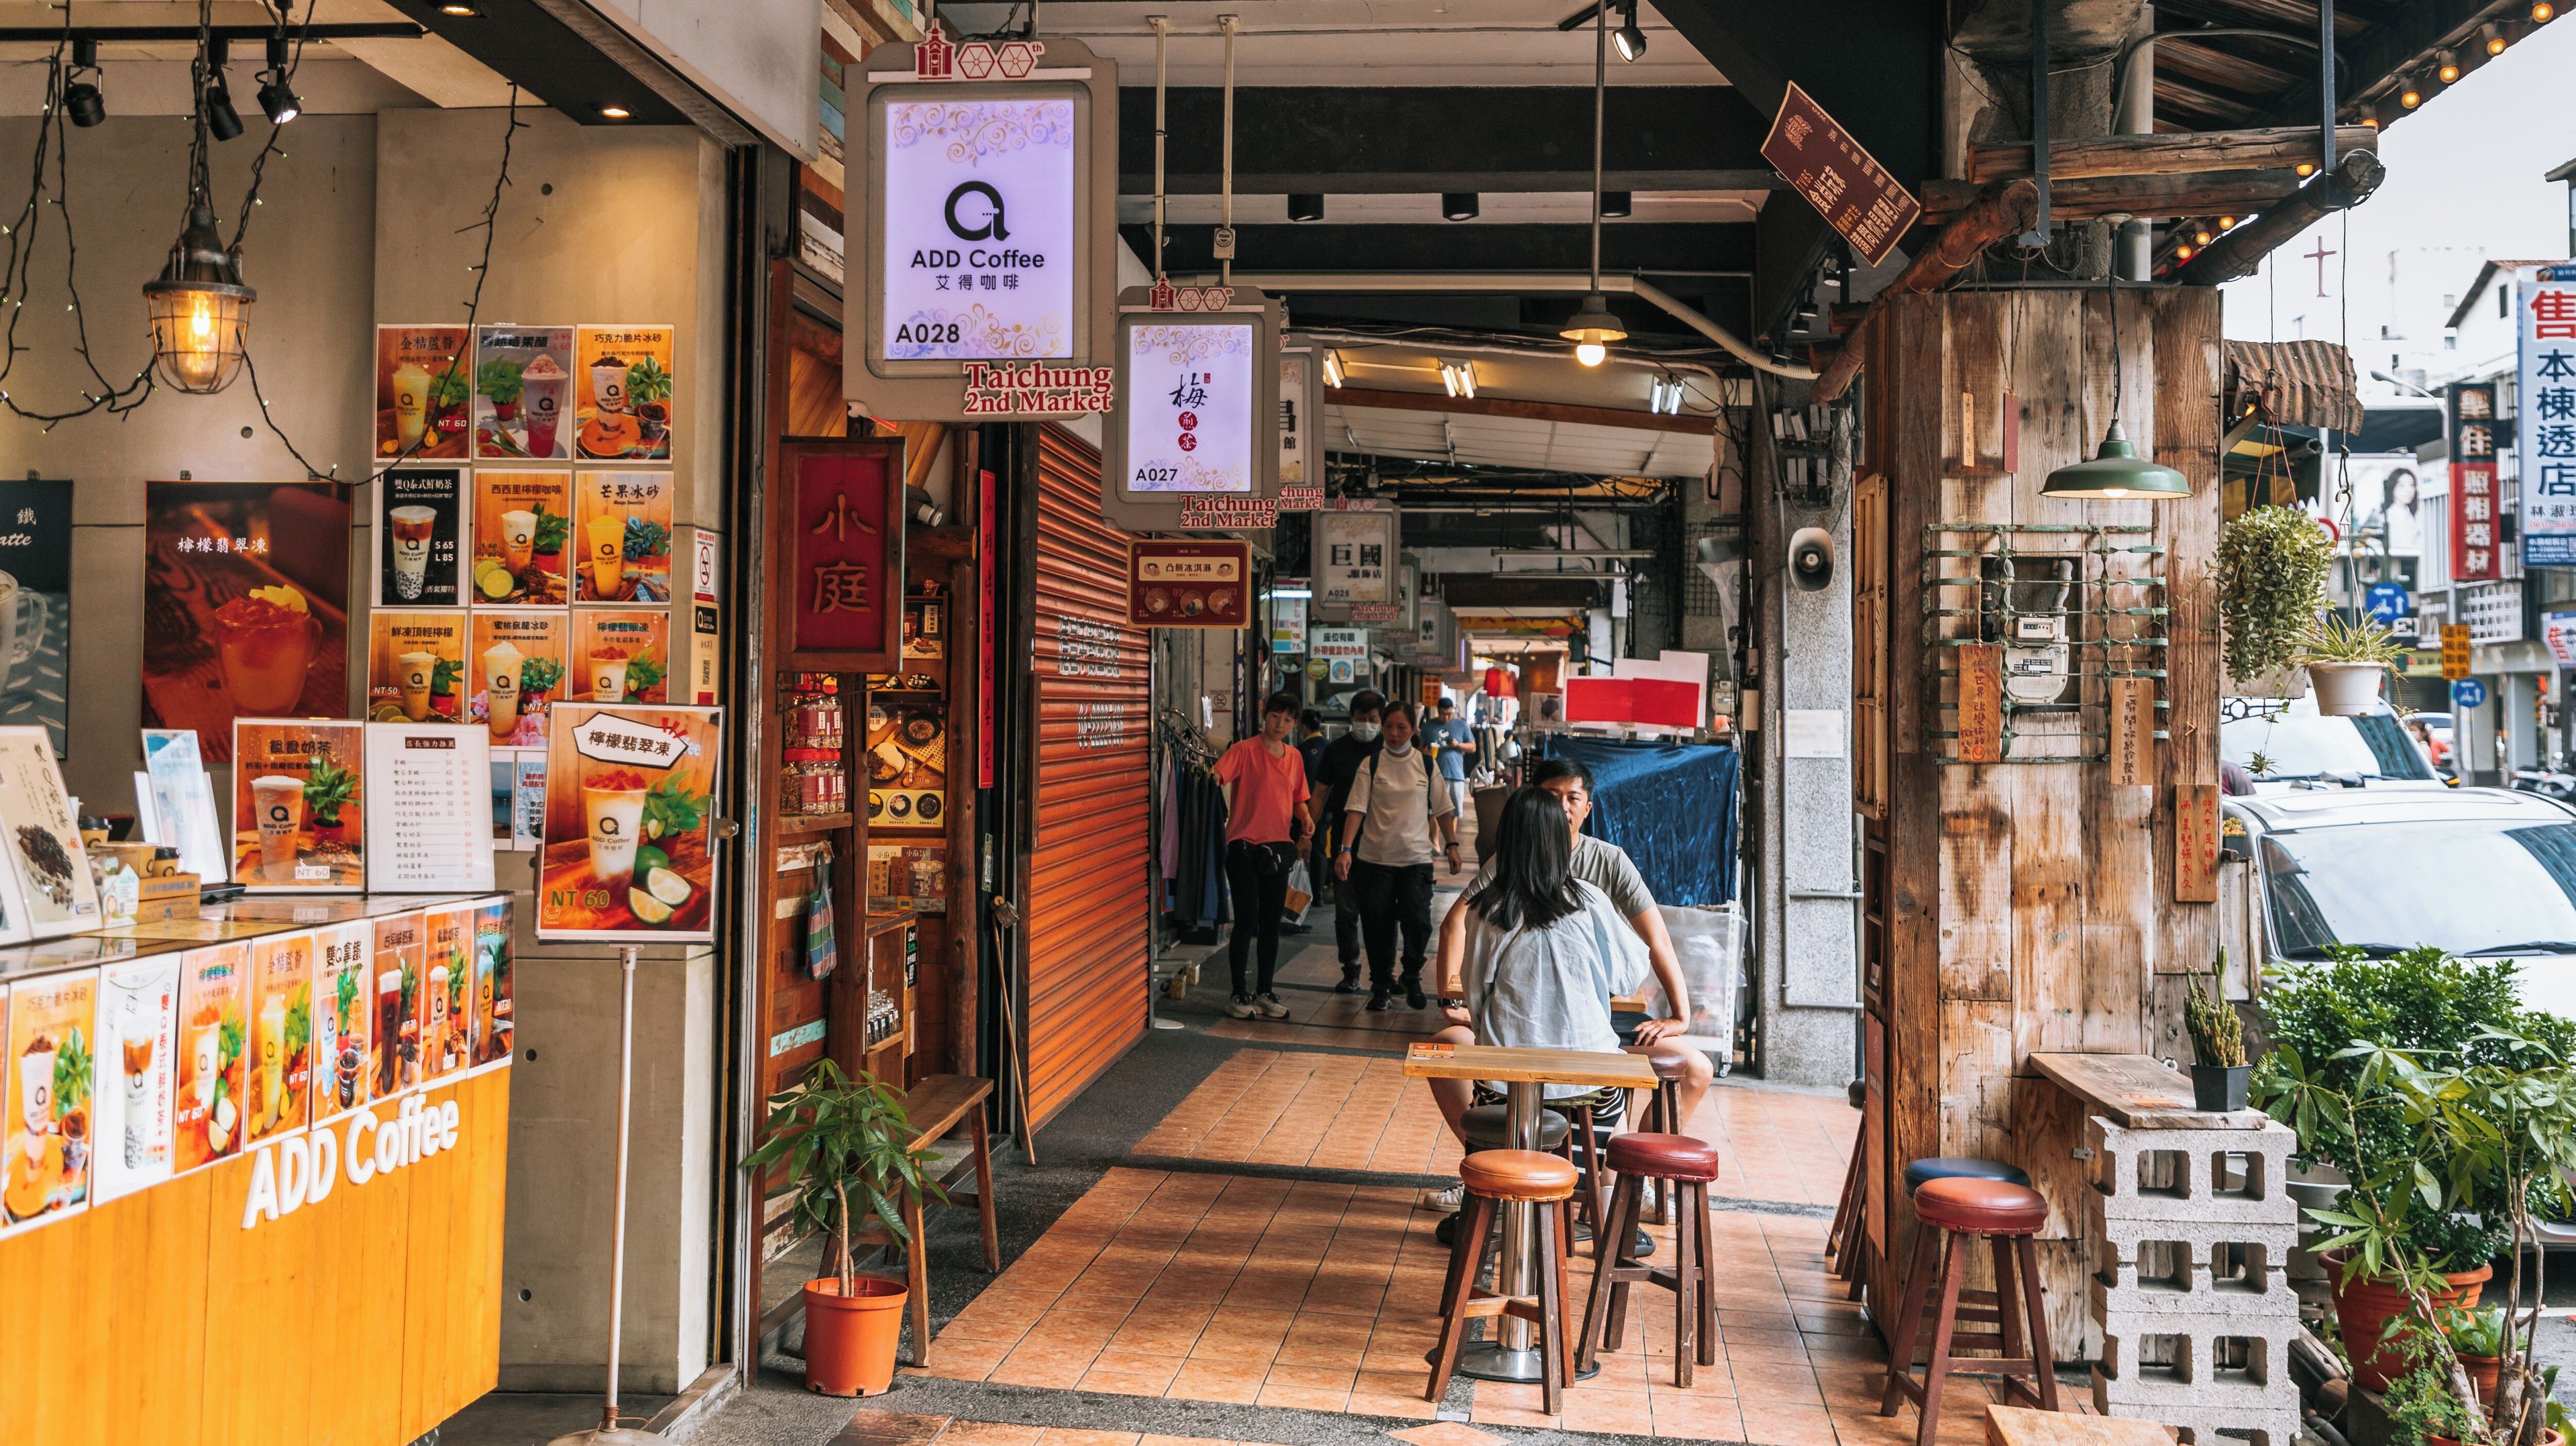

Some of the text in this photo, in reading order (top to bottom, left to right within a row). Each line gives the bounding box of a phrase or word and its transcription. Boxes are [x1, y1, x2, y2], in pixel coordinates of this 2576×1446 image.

[1796, 169, 1813, 190] TVBS
[1809, 165, 1846, 213] 食尚玩家
[910, 249, 1044, 268] ADD Coffee
[935, 274, 1019, 291] 艾得咖啡
[2530, 291, 2576, 340] 售
[594, 333, 661, 343] 巧克力脆片冰砂
[895, 323, 961, 344] A028
[399, 335, 455, 350] 金桔蘆薈
[964, 362, 1112, 392] Taichung
[1169, 372, 1208, 408] 梅
[965, 391, 1112, 414] 2nd Market
[2536, 348, 2576, 497] 本棟透店
[1179, 413, 1197, 450] 煎茶
[1136, 469, 1178, 482] A027
[394, 478, 453, 491] 雙Q泰式鮮奶茶
[491, 484, 562, 495] 西西里檸檬咖啡
[600, 484, 660, 499] 芒果冰砂
[1181, 495, 1276, 515] Taichung
[1281, 499, 1324, 509] Market
[1181, 514, 1276, 527] 2nd Market
[177, 537, 268, 554] 檸檬翡翠凍
[812, 494, 877, 614] 小庭
[1330, 543, 1382, 566] 巨國
[1166, 564, 1212, 572] 凸餅冰淇淋
[1348, 569, 1382, 578] 服飾店
[1328, 589, 1350, 597] A025
[391, 627, 453, 637] 鮮凍頂輕檸檬
[494, 621, 549, 630] 蜜桃烏龍冰砂
[597, 622, 649, 632] 檸檬翡翠凍
[1324, 633, 1355, 642] 座位有限
[270, 740, 331, 755] 鴛鴦奶茶
[589, 730, 671, 757] 檸檬翡翠凍
[297, 868, 329, 877] NT 60
[551, 890, 610, 907] NT 60
[268, 949, 302, 975] 金桔蘆薈
[326, 940, 362, 967] 雙Q拿鐵
[290, 1071, 308, 1084] NT 60
[178, 1110, 190, 1123] NT
[241, 1094, 460, 1229] ADD Coffee
